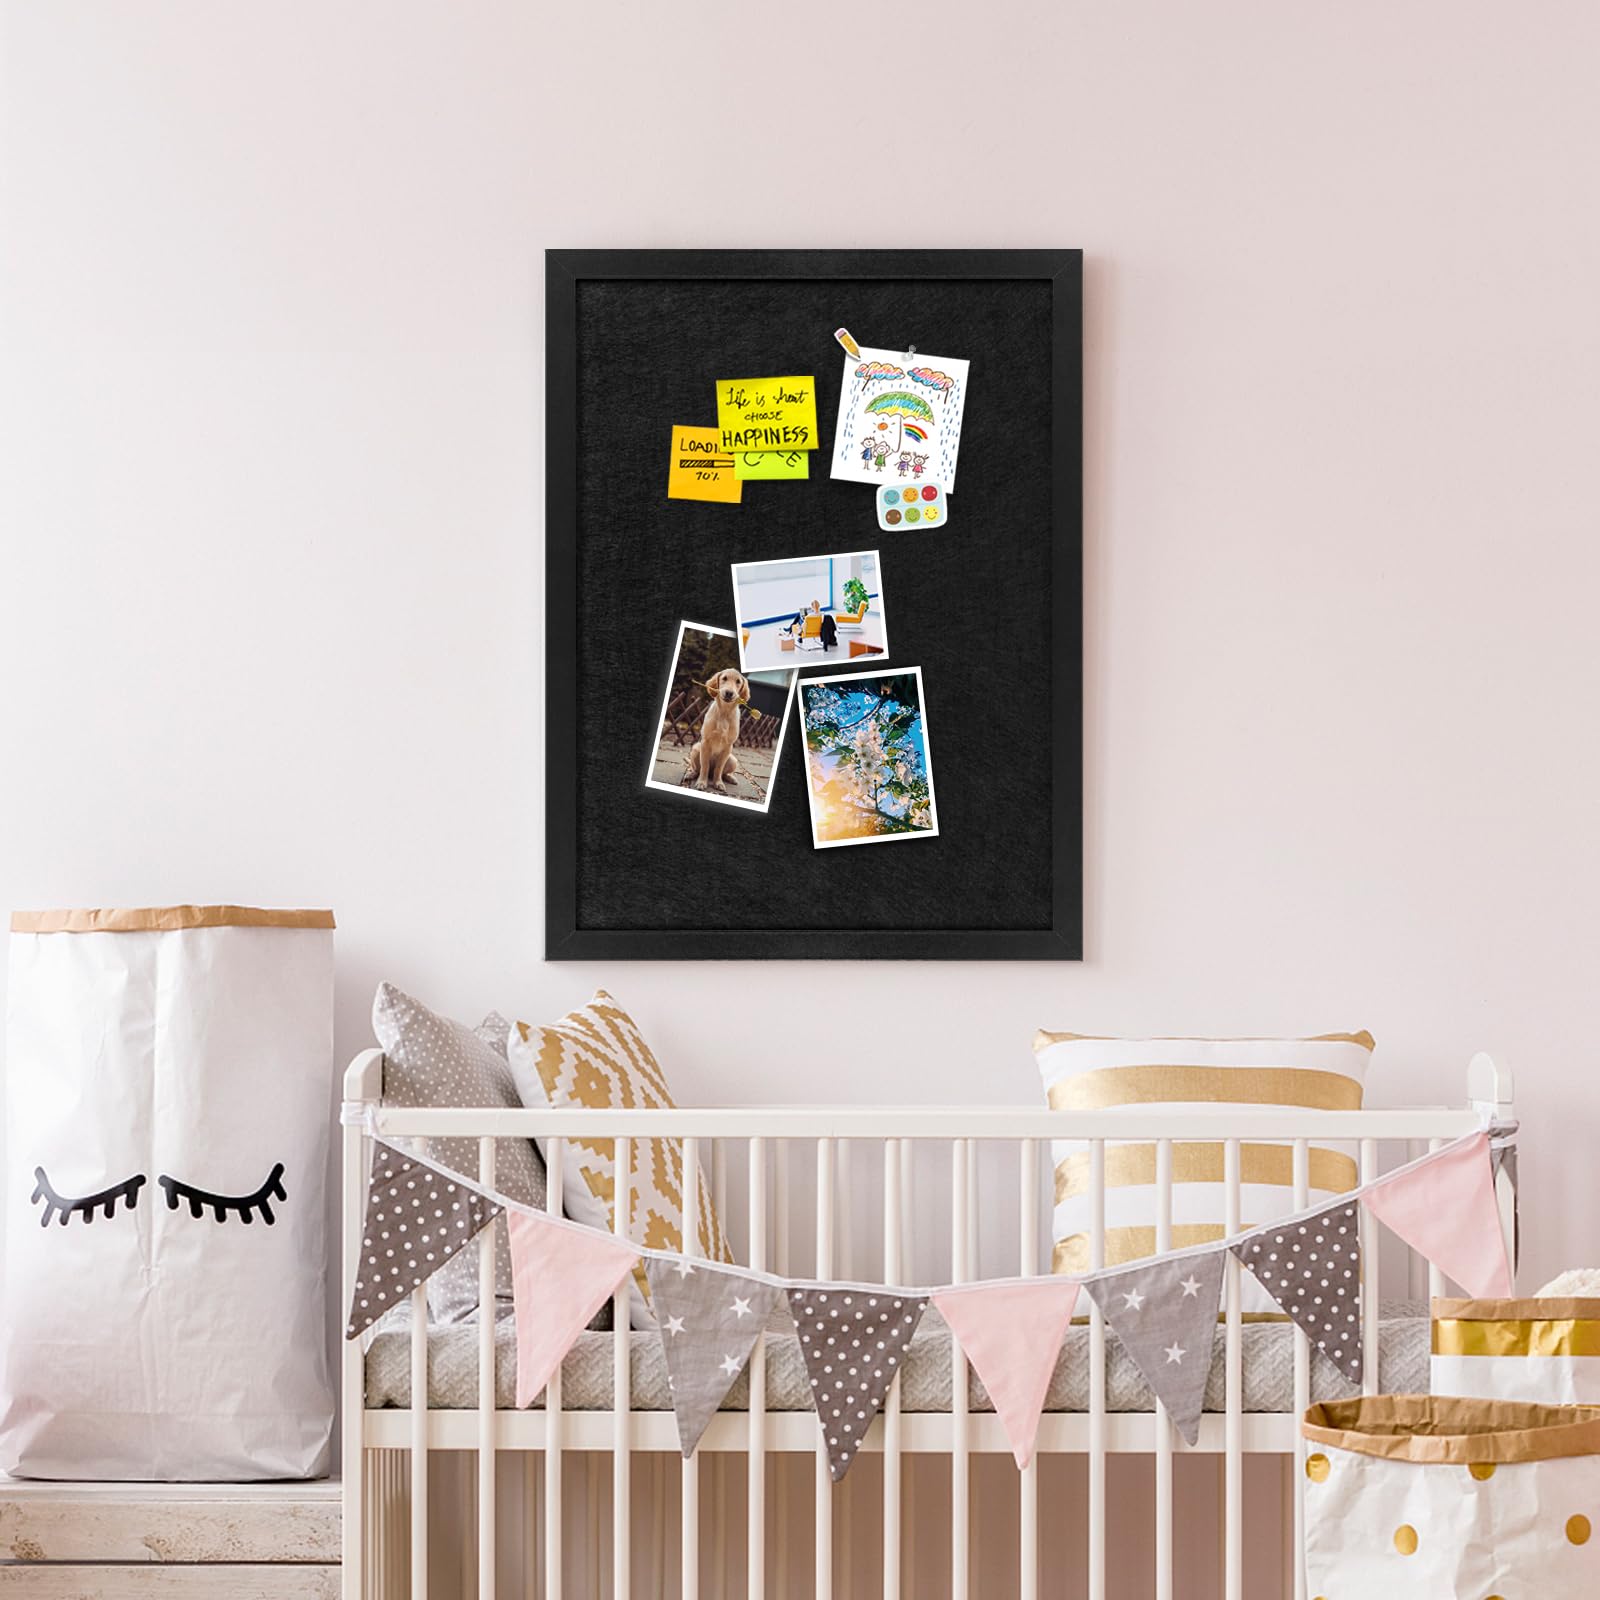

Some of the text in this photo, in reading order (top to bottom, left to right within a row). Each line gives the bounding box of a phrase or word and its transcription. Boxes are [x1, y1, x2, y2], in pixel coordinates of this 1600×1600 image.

[725, 387, 751, 410] Life
[755, 392, 766, 406] is
[744, 410, 783, 423] CHOOSE
[680, 437, 735, 455] LOADI
[722, 426, 809, 448] HAPPINESS
[695, 471, 720, 481] 70%
